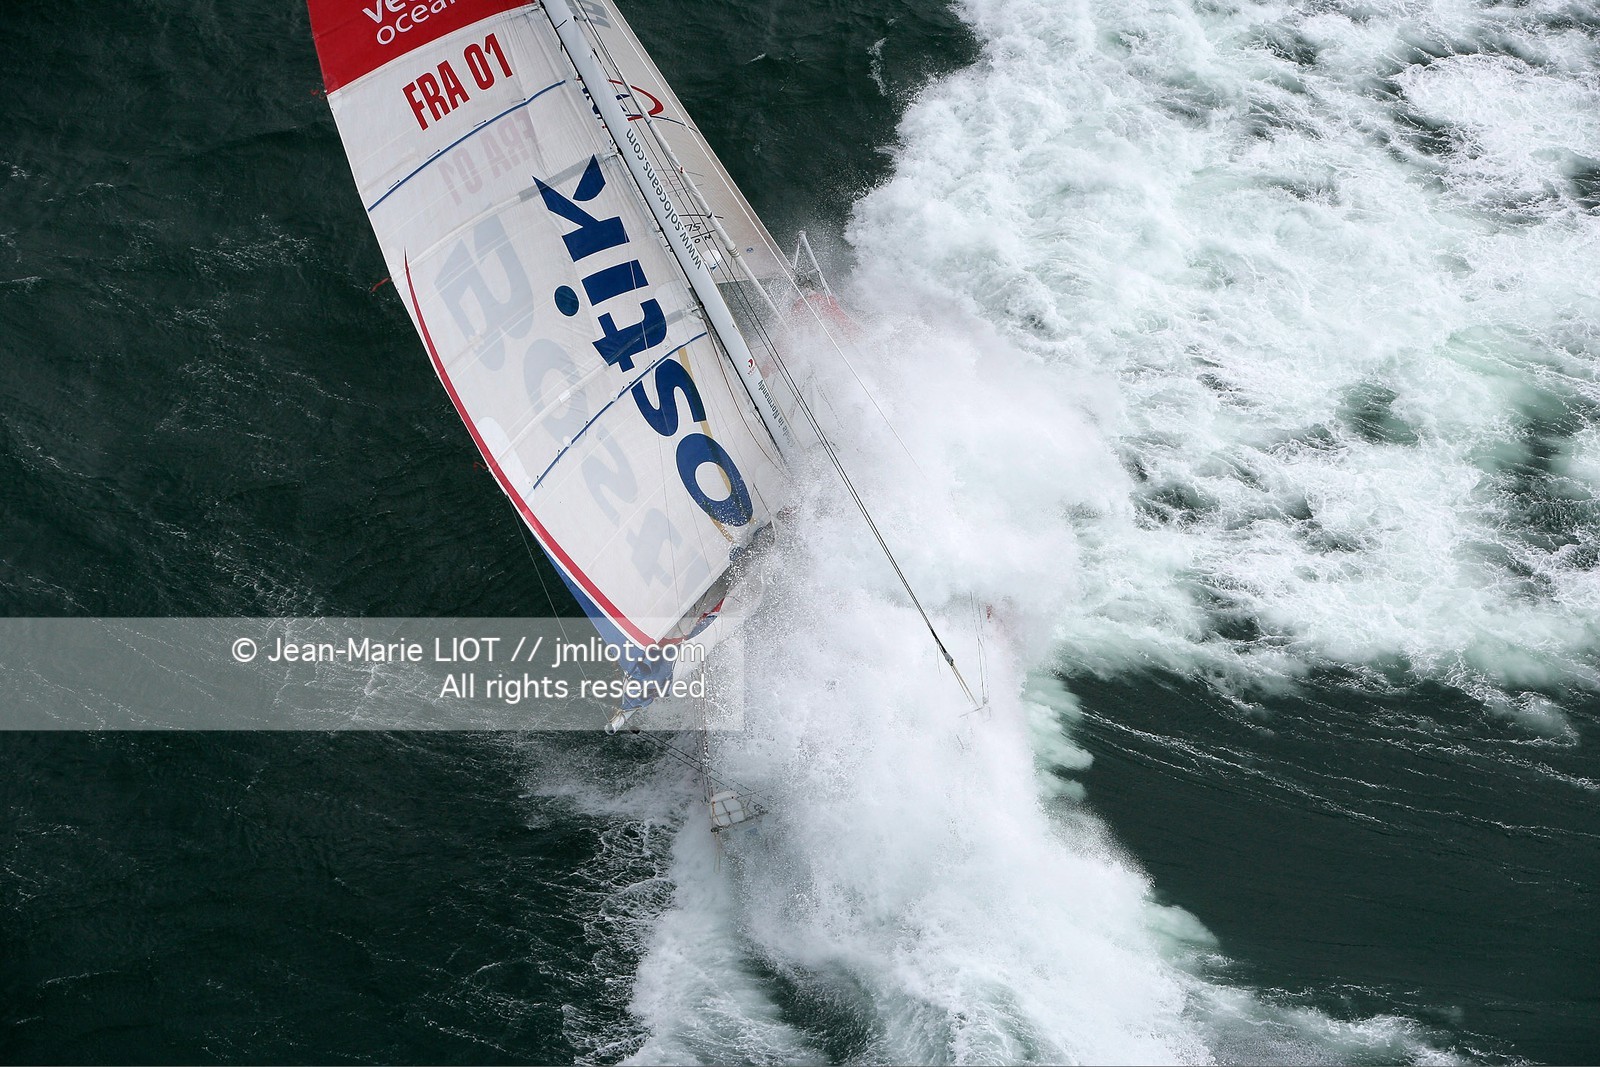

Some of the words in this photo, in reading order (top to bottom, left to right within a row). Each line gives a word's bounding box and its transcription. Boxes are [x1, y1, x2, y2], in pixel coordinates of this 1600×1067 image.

[376, 0, 456, 45] ocea
[403, 60, 470, 131] FRA
[463, 33, 513, 90] 01
[625, 127, 704, 270] www.soloceans.com
[532, 155, 754, 530] ostik
[757, 379, 780, 419] Normandy
